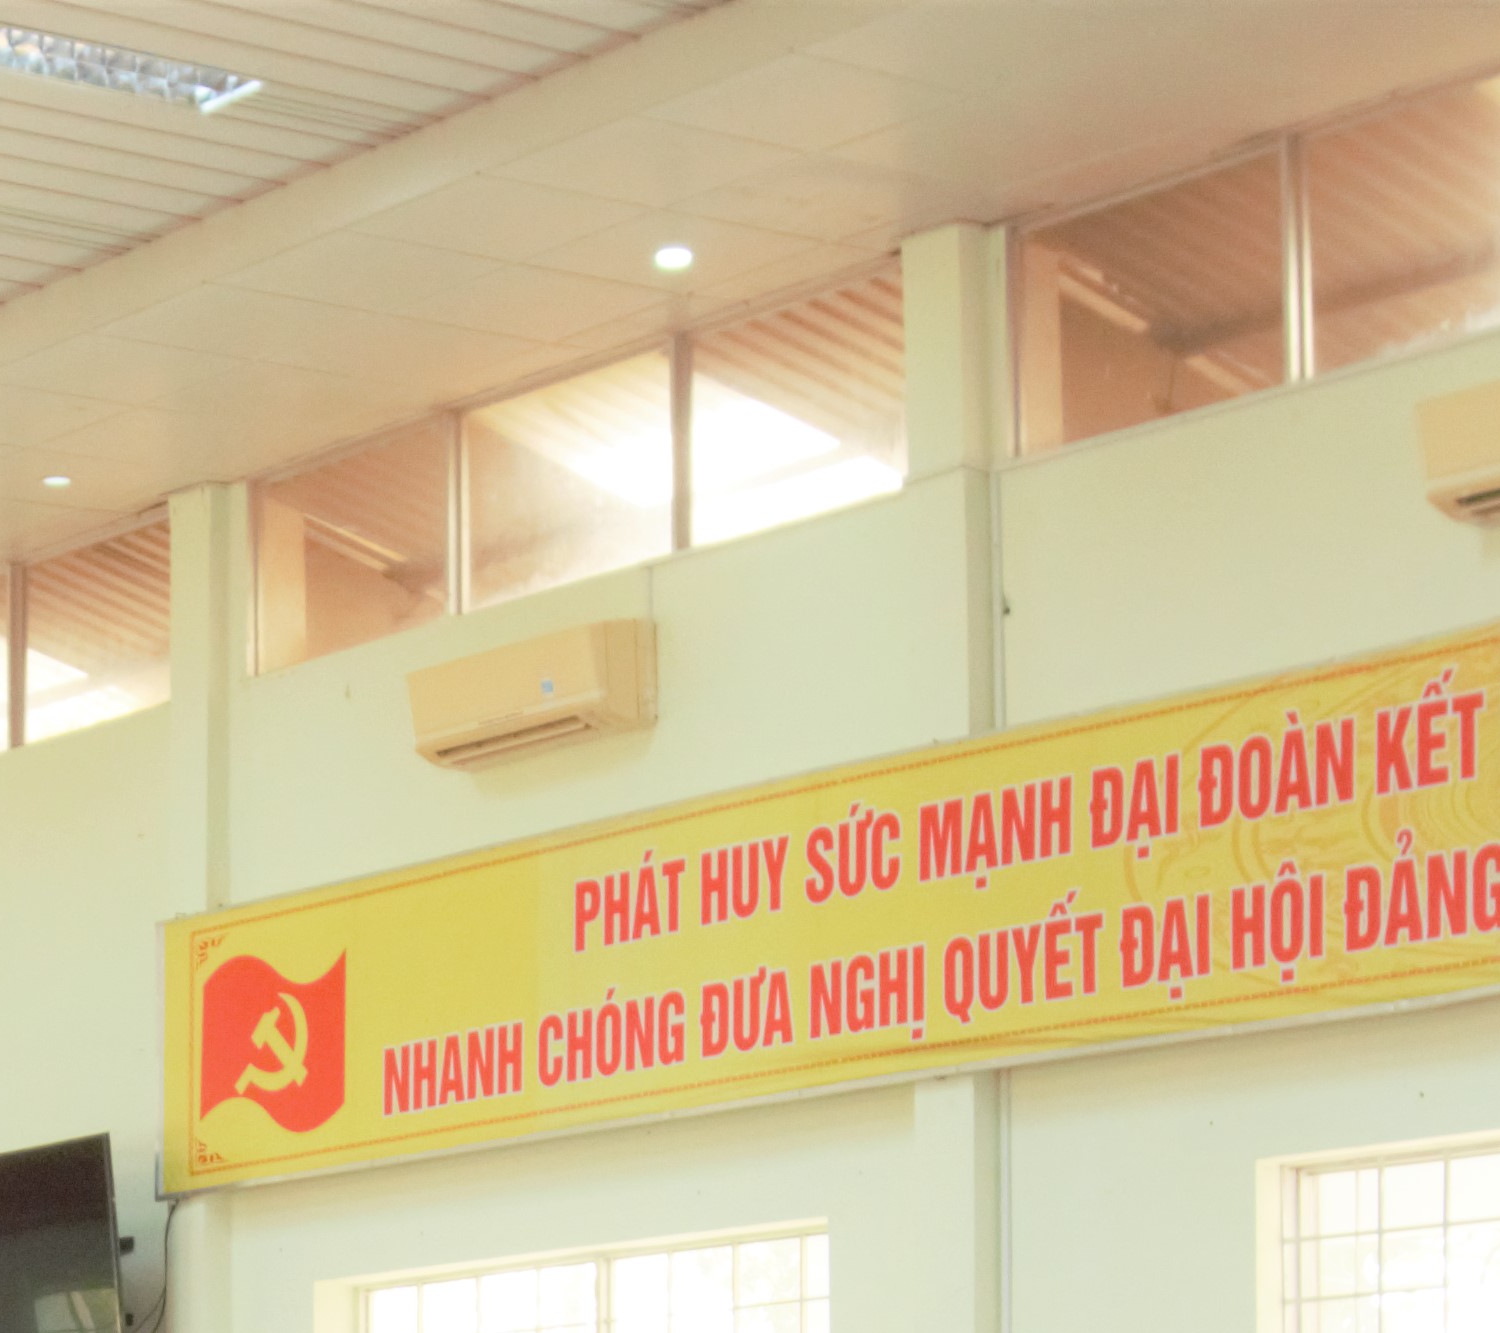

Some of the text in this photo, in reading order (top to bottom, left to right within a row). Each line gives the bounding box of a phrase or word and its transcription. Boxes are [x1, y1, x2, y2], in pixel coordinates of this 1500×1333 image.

[573, 858, 687, 953] PHÁT
[699, 836, 790, 927] HUY
[804, 809, 902, 905] SỨC
[918, 775, 1073, 890] MẠNH
[1088, 754, 1180, 860] ĐẠI
[1196, 717, 1355, 829] ĐOÀN
[1375, 681, 1485, 796] KẾT
[382, 1022, 524, 1116] NHANH
[537, 990, 686, 1088] CHÓNG
[698, 966, 794, 1058] ĐƯA
[808, 945, 926, 1041] NGHỊ
[942, 901, 1104, 1025] QUYẾT
[1118, 893, 1211, 1000] ĐẠI
[1230, 861, 1325, 983] HỘI
